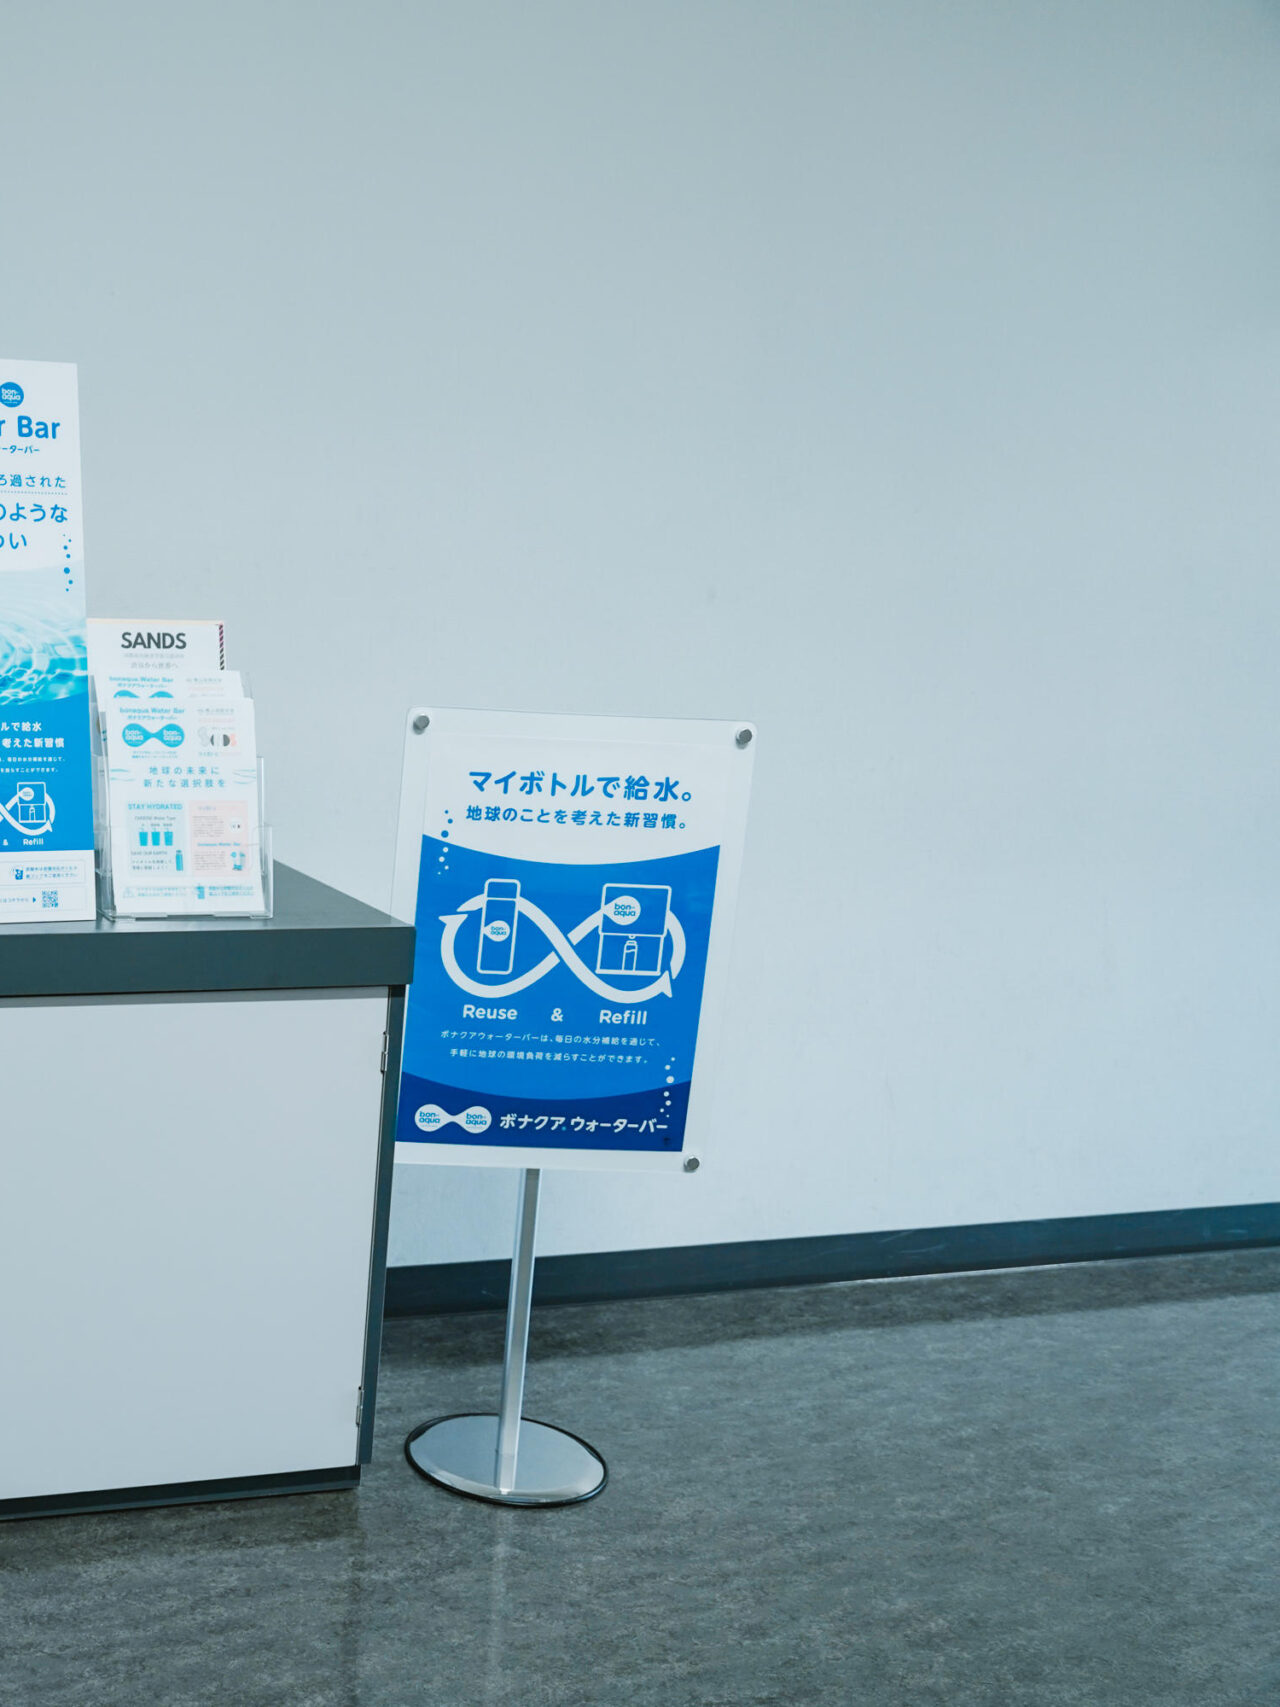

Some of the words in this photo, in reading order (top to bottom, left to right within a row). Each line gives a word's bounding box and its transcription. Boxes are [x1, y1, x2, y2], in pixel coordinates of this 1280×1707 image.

[17, 415, 61, 439] Bar
[121, 631, 187, 650] SANDS
[468, 770, 692, 802] マイボトルで給水。
[465, 805, 686, 830] 地球のことを考えた新習慣。
[22, 838, 44, 846] Refill
[613, 909, 636, 918] aqua
[462, 1003, 518, 1021] Reuse
[550, 1007, 564, 1023] &
[599, 1008, 648, 1025] Refill
